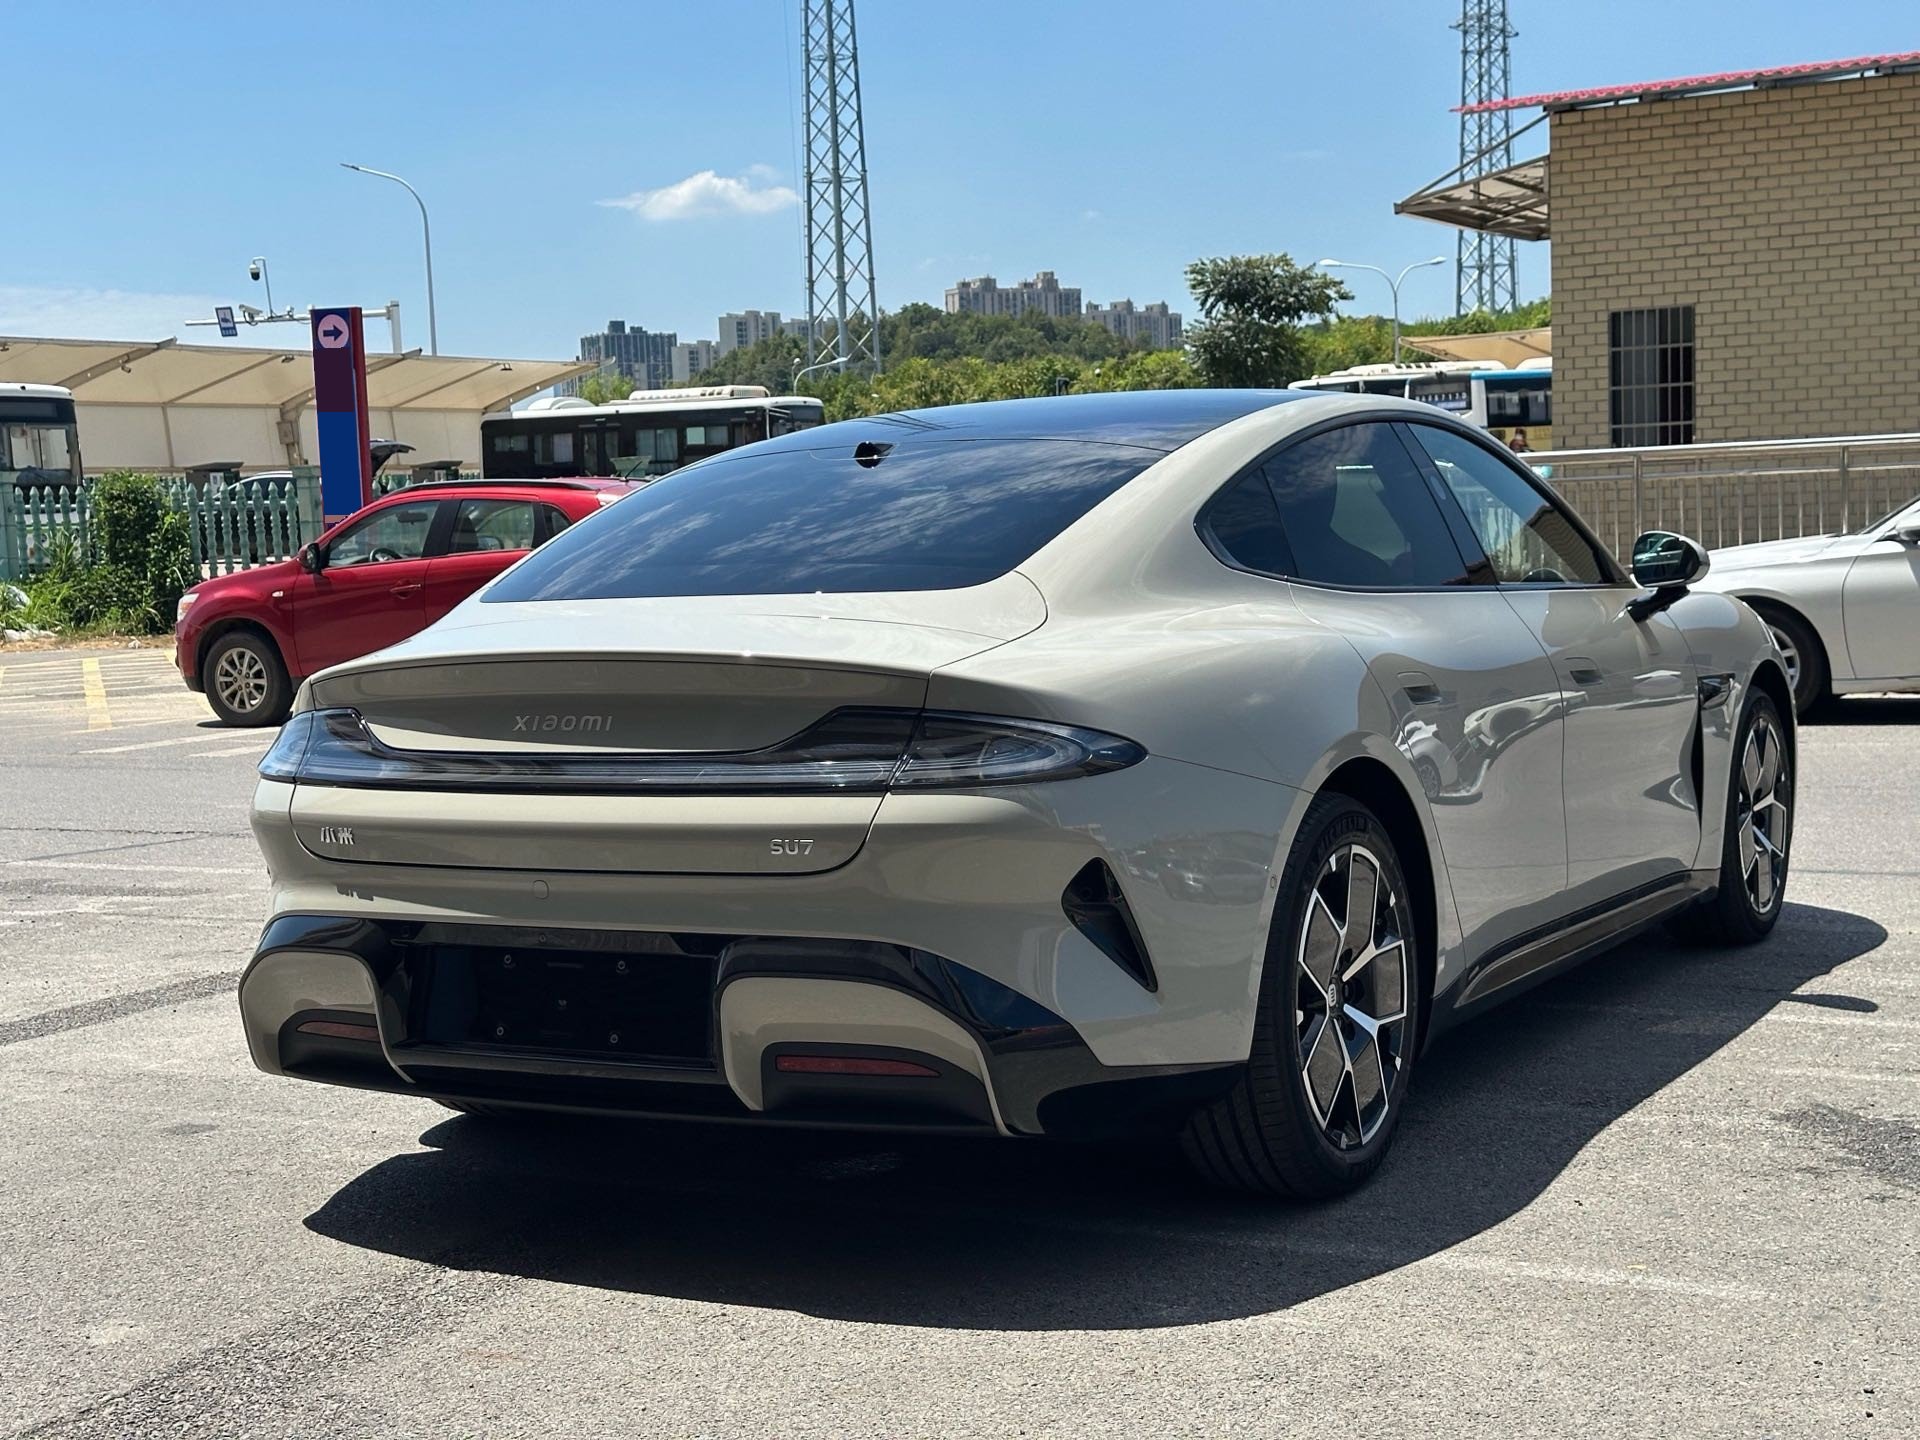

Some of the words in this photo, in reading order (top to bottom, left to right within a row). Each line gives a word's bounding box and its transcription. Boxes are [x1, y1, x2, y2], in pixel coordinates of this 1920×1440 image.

[512, 714, 613, 731] xiaomi
[320, 826, 354, 845] 小米
[769, 839, 814, 855] SU7
